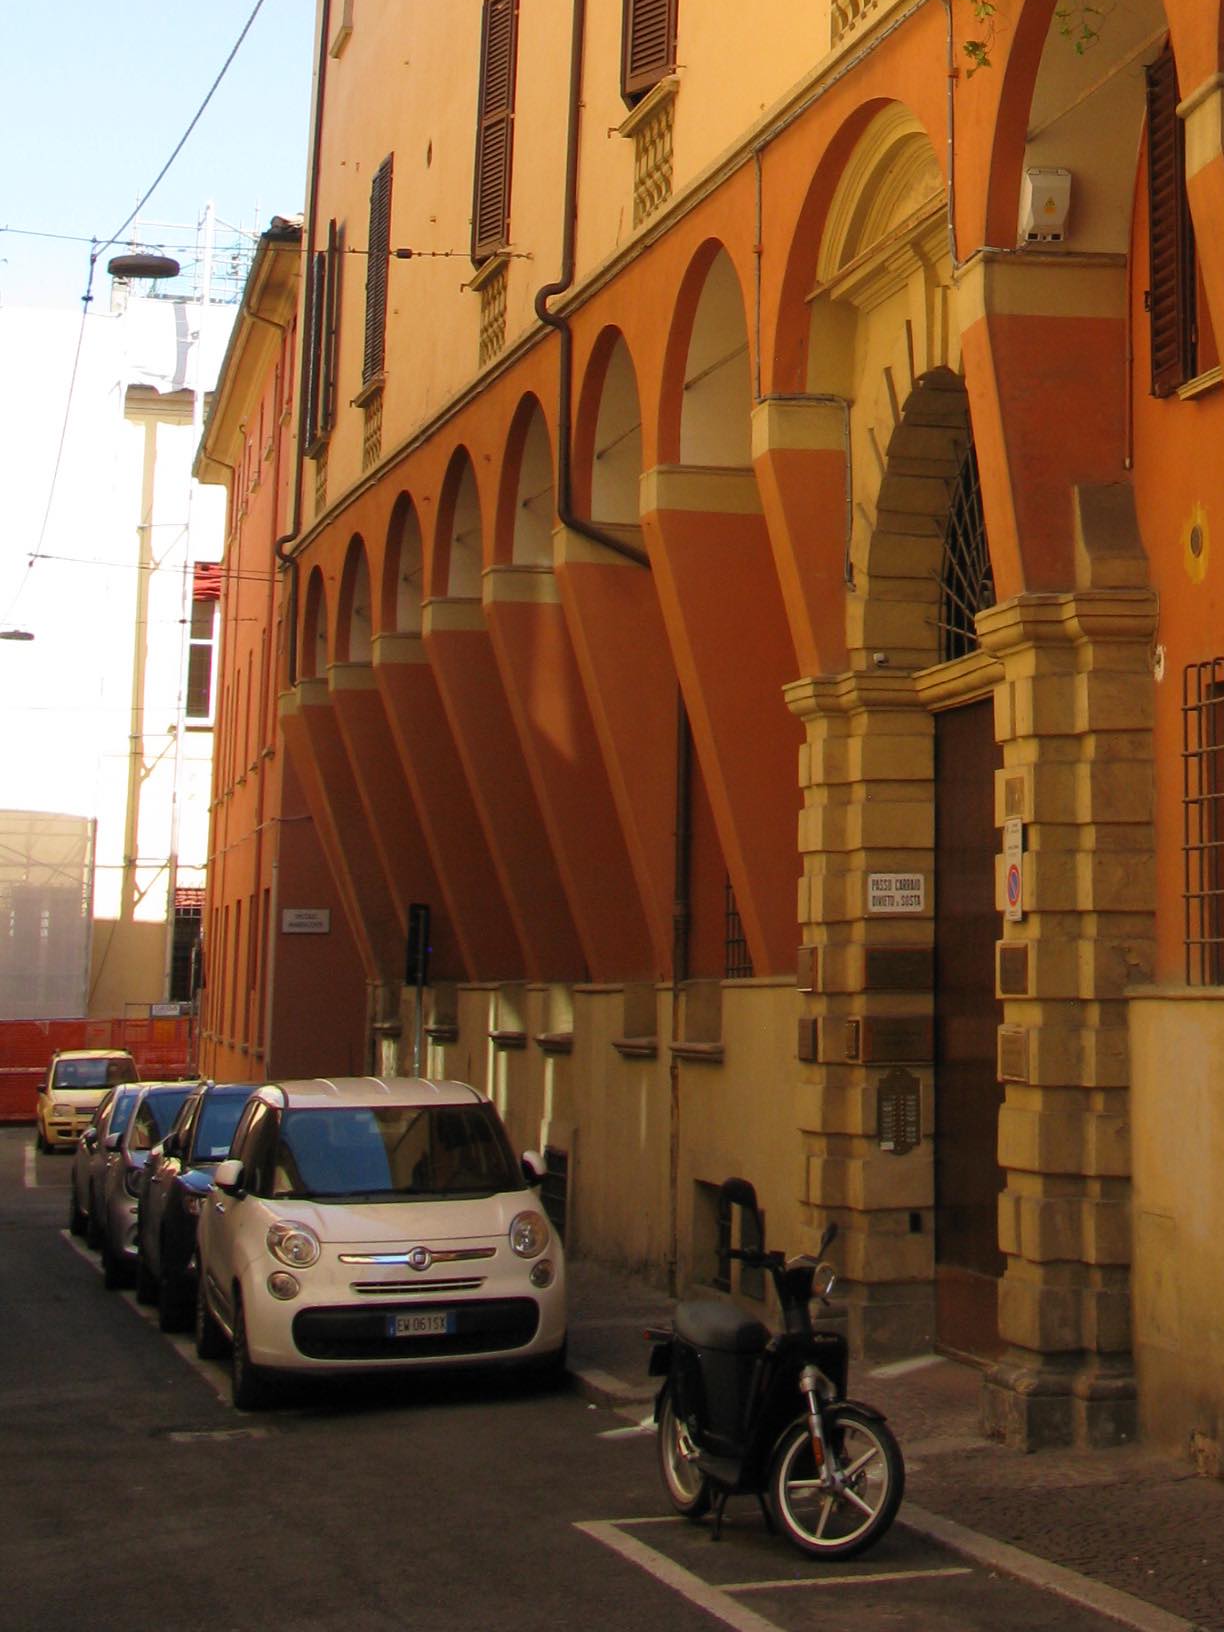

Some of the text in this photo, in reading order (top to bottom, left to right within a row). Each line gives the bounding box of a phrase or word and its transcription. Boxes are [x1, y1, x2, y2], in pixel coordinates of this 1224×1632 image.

[872, 878, 921, 891] PASSO CARRAIO
[872, 895, 895, 907] DIVIETO
[901, 895, 921, 906] SOSTA
